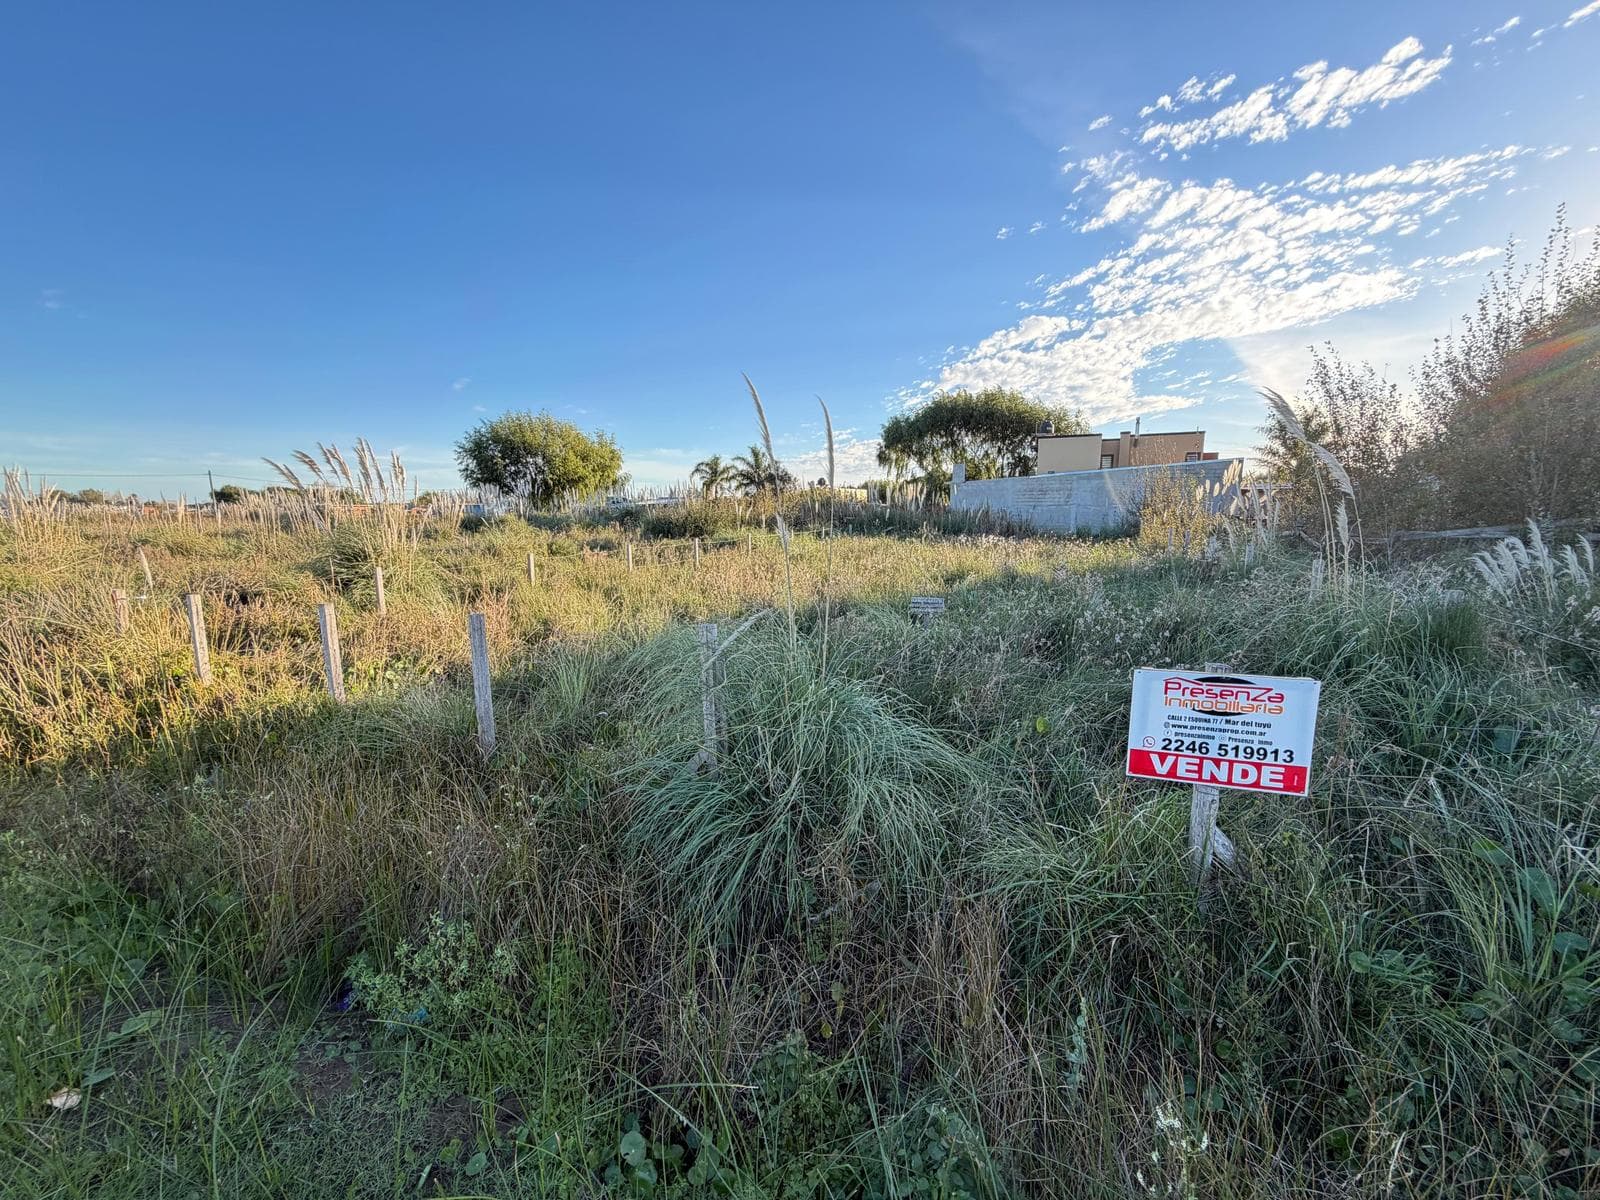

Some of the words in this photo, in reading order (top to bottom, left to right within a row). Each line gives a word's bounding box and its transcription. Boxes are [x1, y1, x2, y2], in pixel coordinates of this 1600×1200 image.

[1171, 723, 1267, 736] www.presenzaprop.com.ar
[1188, 716, 1211, 724] ESQUINA
[1225, 718, 1239, 726] Mar
[1240, 719, 1253, 727] del
[1161, 738, 1210, 755] 2246
[1217, 743, 1295, 763] 519913
[1149, 753, 1286, 789] VENDE
